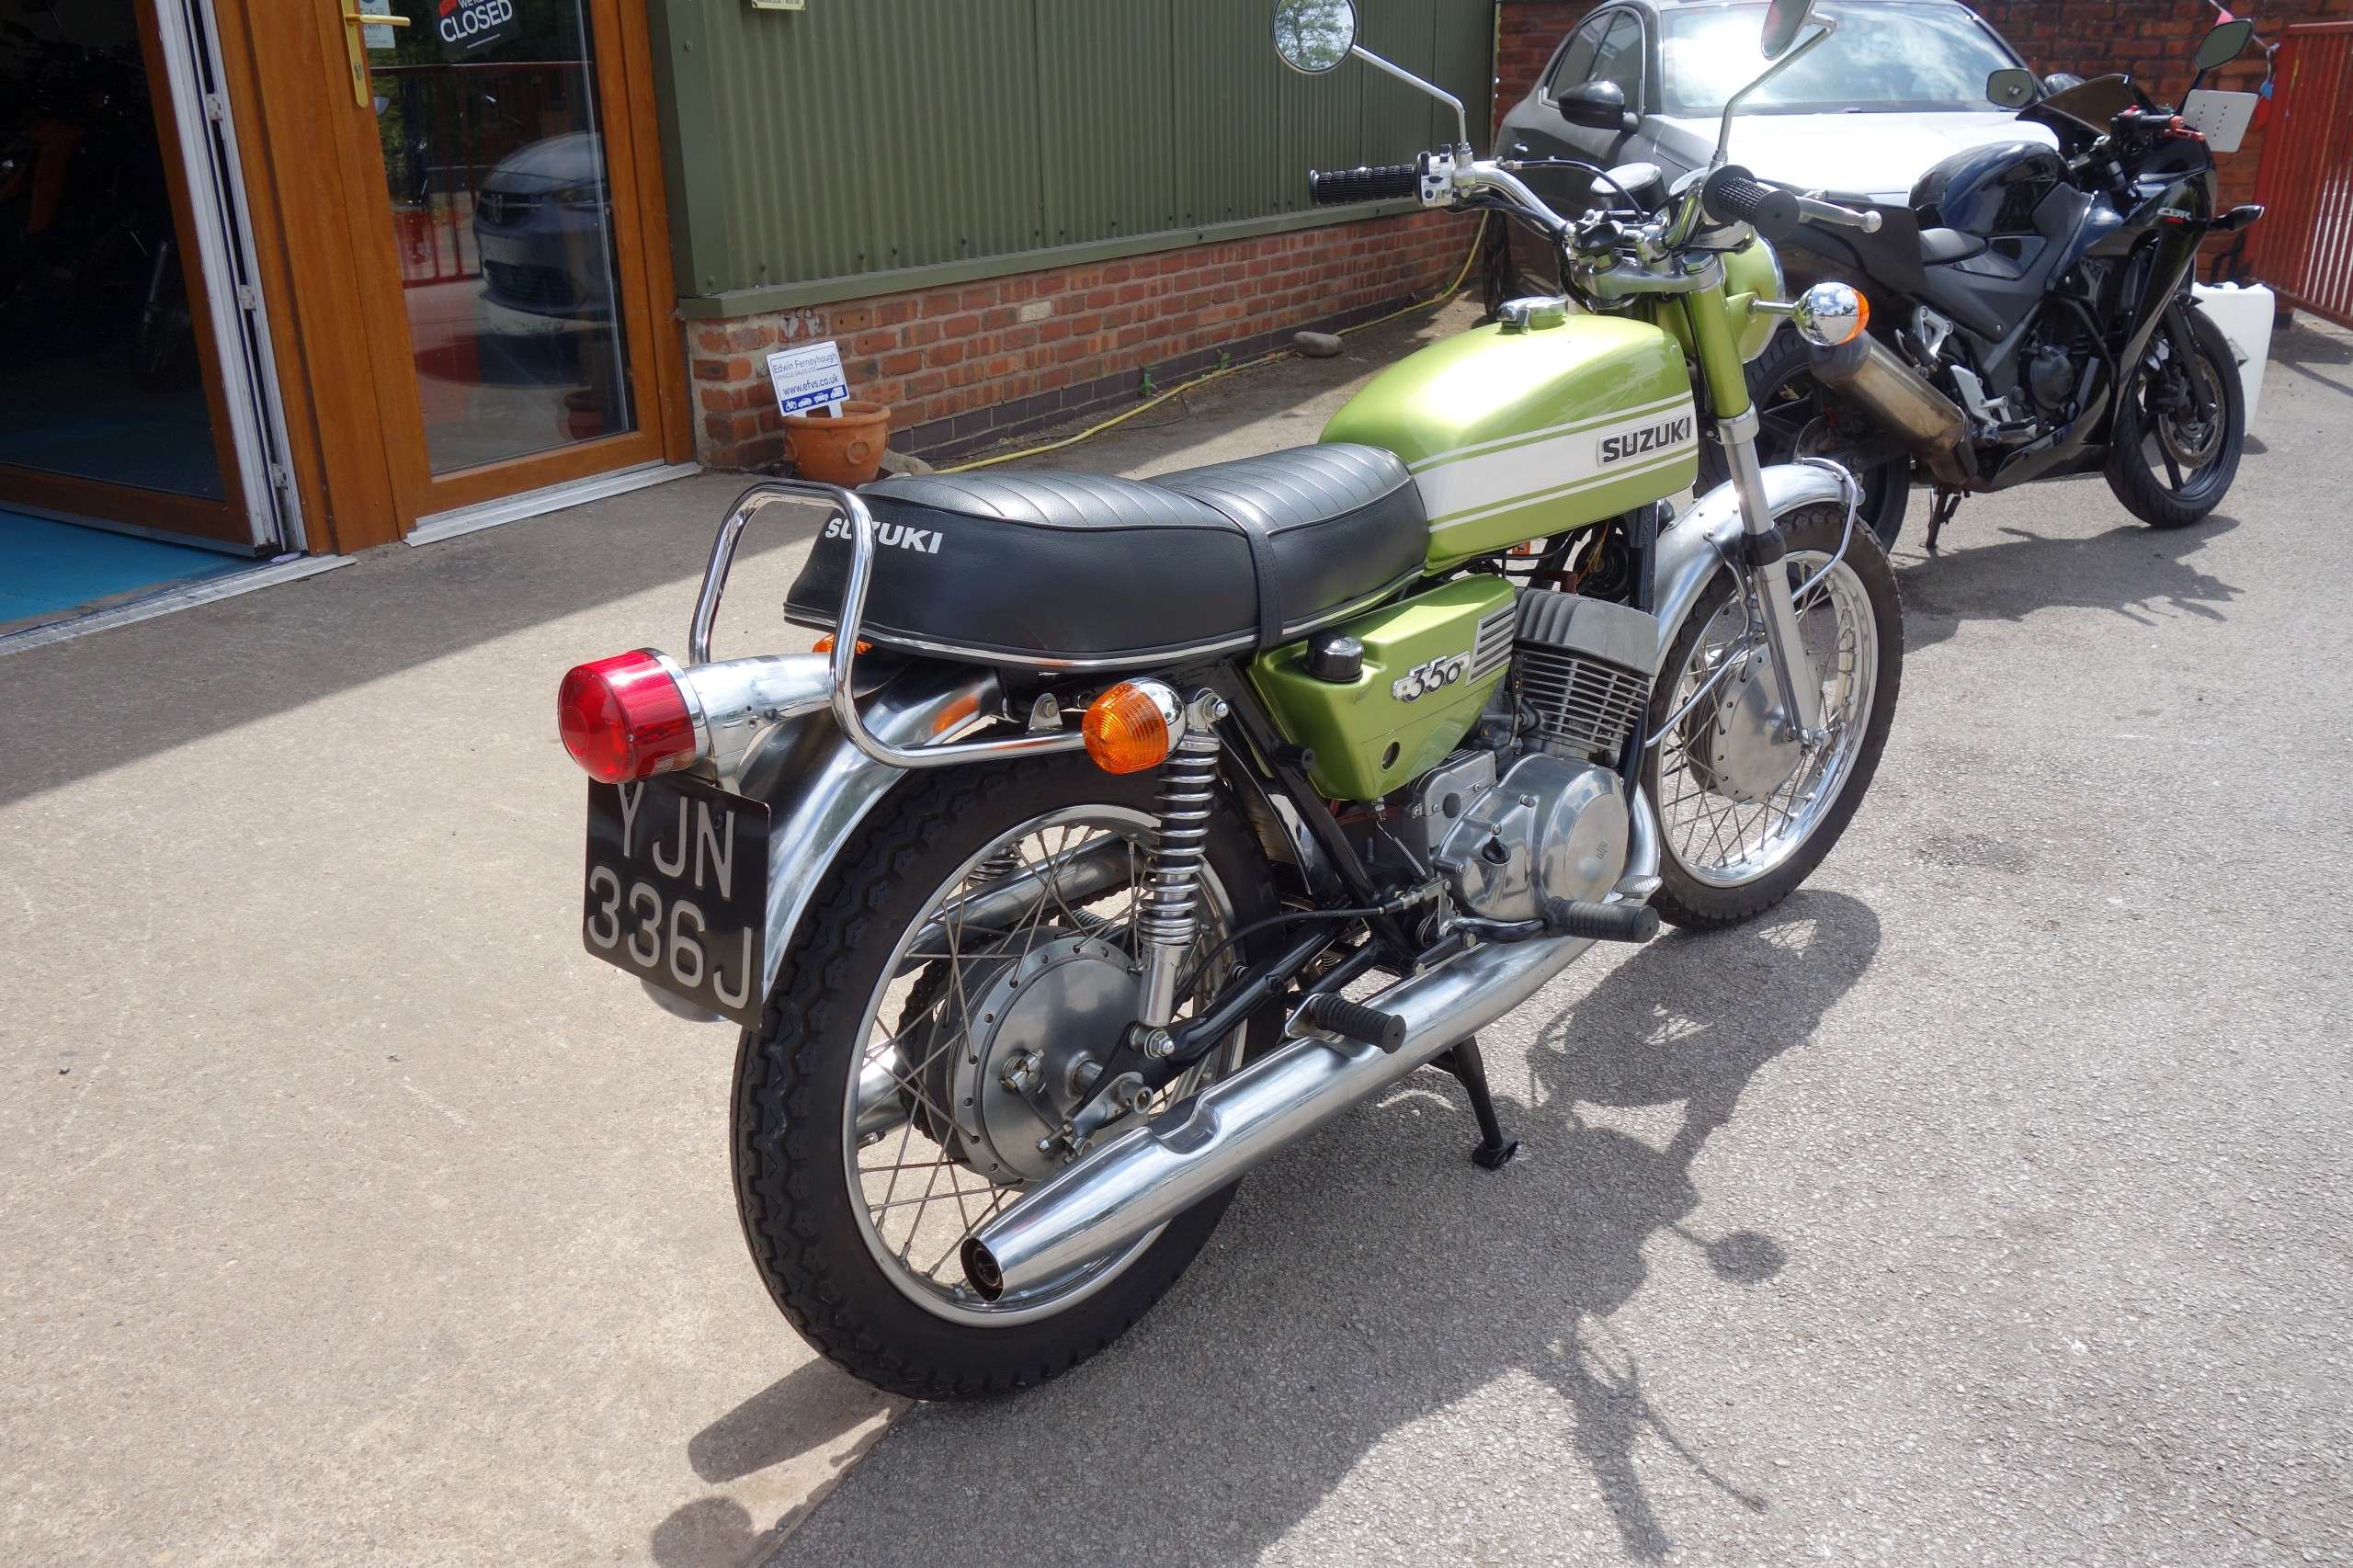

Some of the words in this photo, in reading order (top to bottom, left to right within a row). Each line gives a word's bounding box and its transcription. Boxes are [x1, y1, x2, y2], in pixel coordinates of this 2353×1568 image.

[440, 0, 513, 42] CLOSED
[773, 362, 794, 374] Edwin
[795, 352, 836, 369] Ferneyhough
[782, 374, 838, 395] www.efvs.co.uk
[1603, 416, 1690, 463] SUZUKI
[824, 517, 943, 554] SUUKI
[1404, 655, 1461, 701] 350
[618, 780, 734, 900] YJN
[587, 865, 752, 1009] 336J
